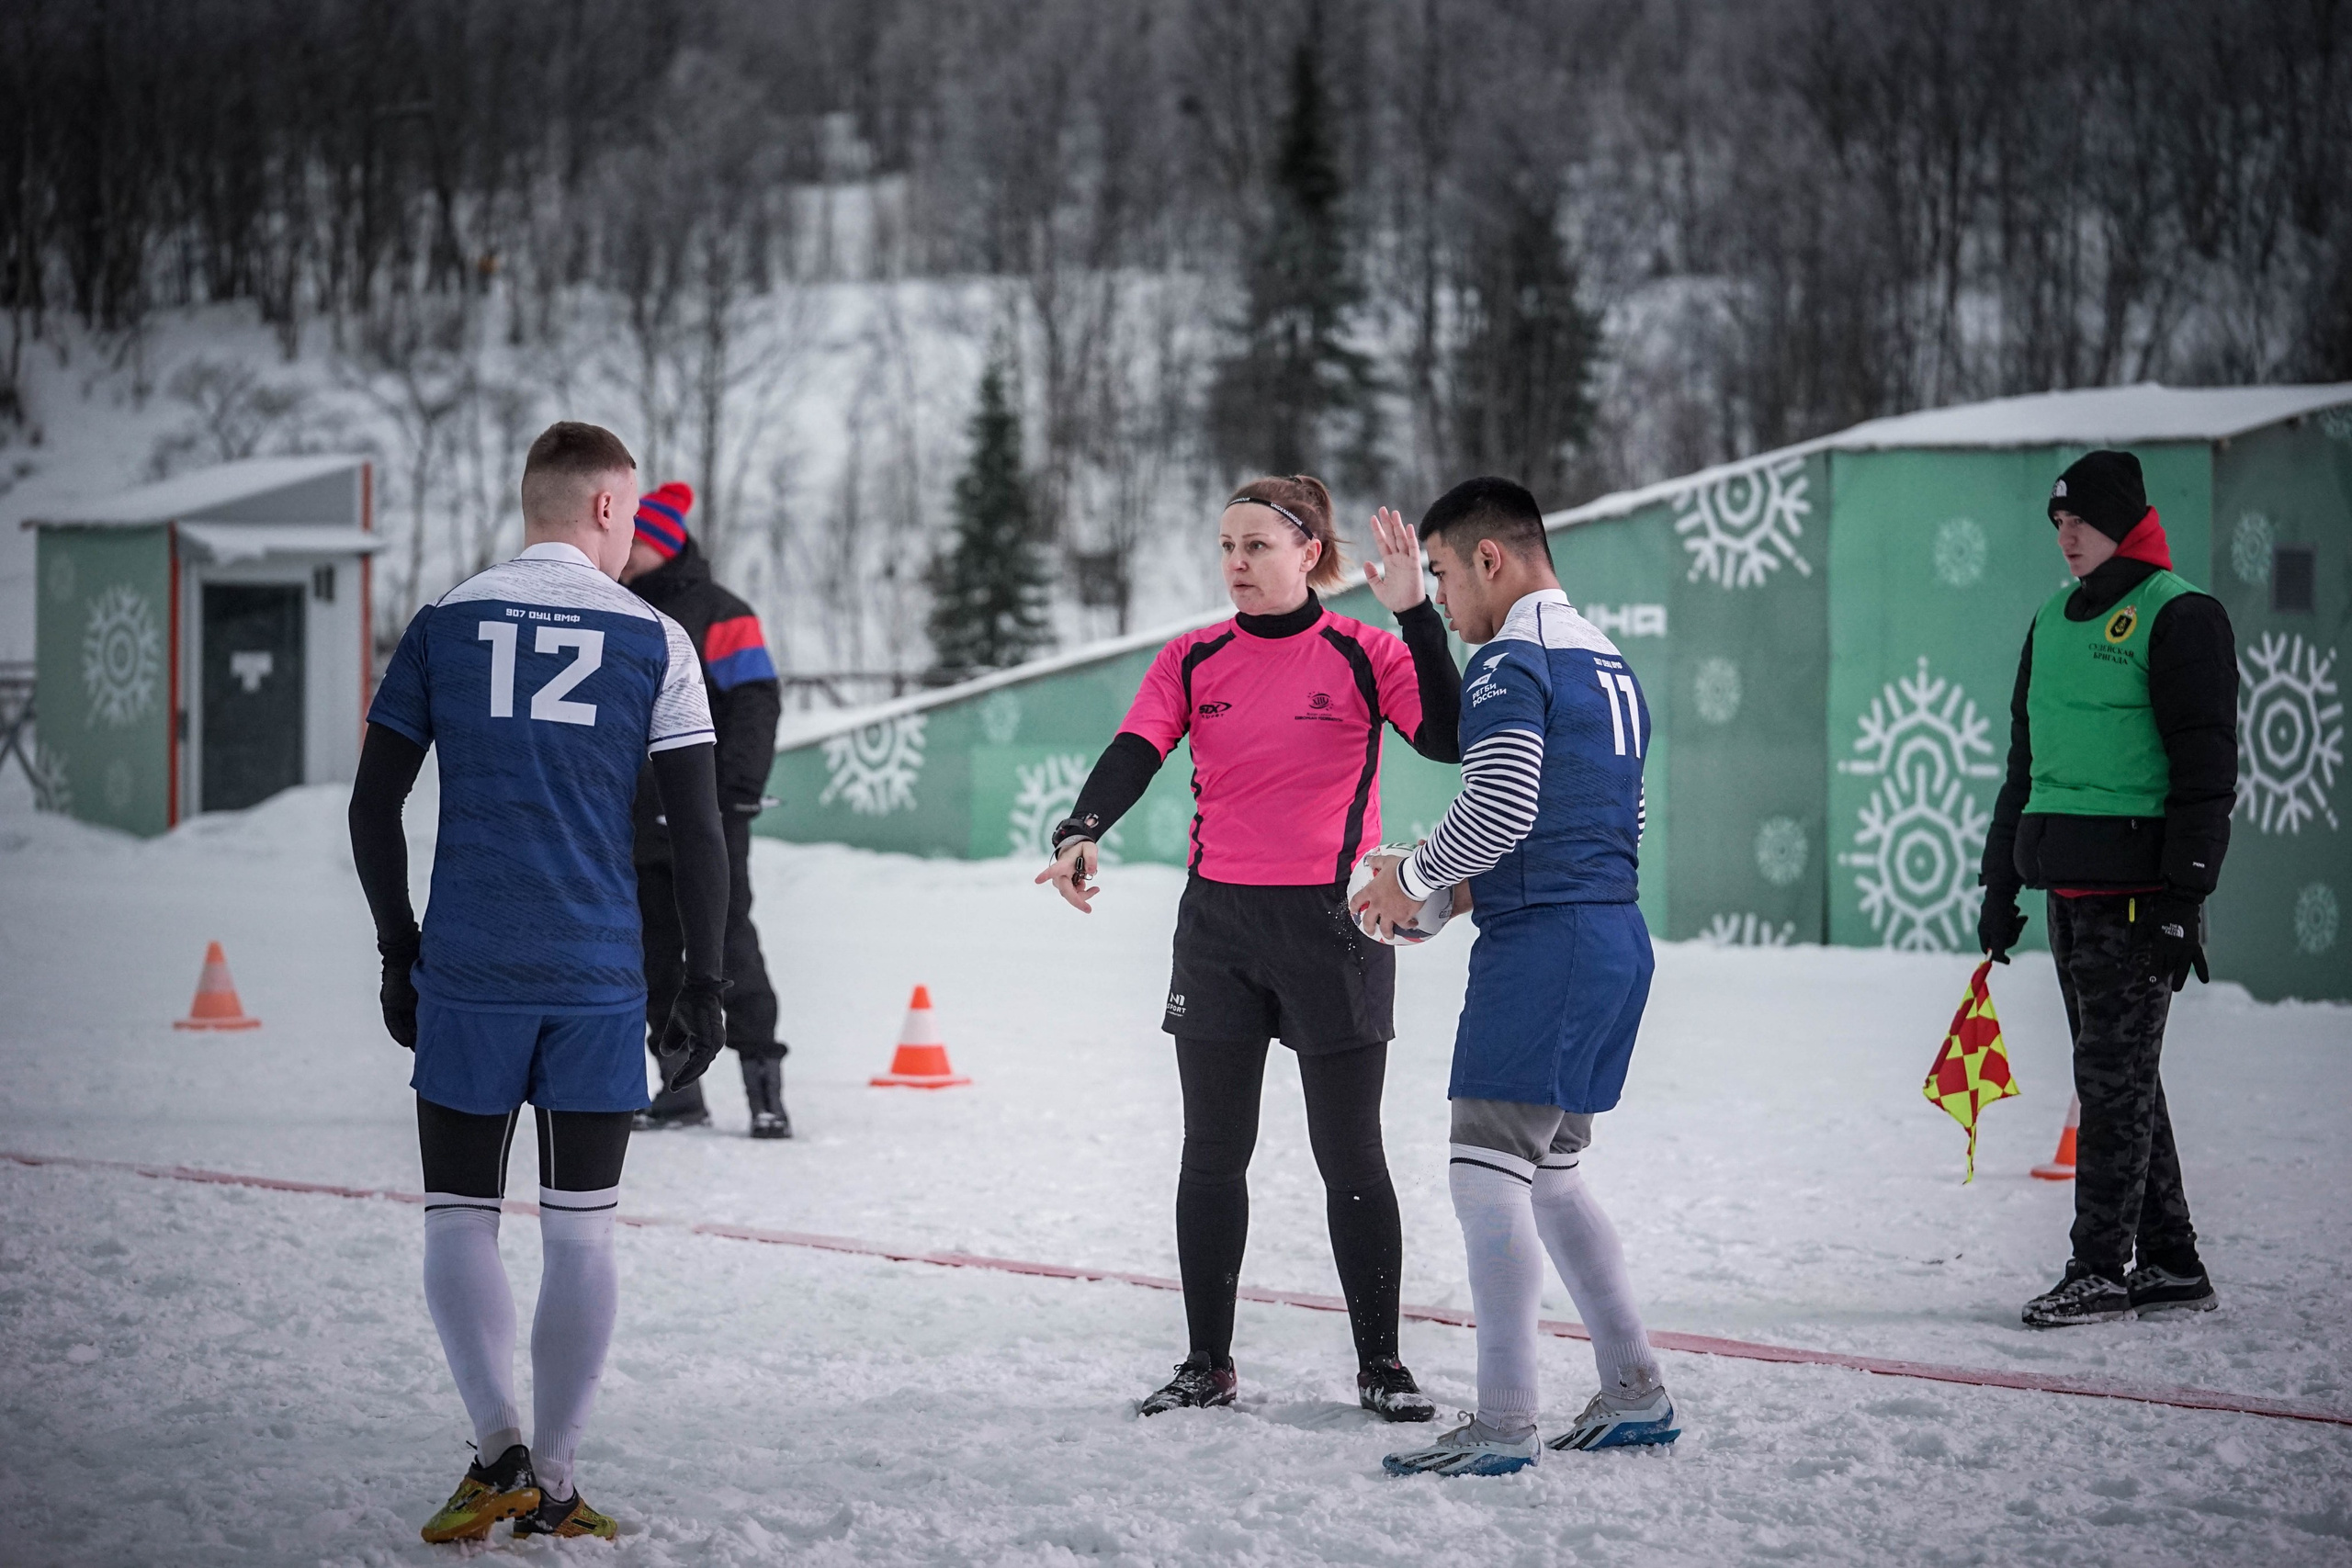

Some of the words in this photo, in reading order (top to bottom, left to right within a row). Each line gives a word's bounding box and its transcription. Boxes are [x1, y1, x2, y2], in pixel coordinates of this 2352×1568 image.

[505, 608, 526, 618] 907
[528, 611, 551, 621] ОУЦ
[553, 613, 581, 623] ВМФ
[478, 621, 605, 727] 12
[1472, 682, 1497, 700] РЕГБИ
[1472, 688, 1507, 708] РОССИИ
[1596, 669, 1641, 760] 11
[1167, 1002, 1186, 1014] SPORT
